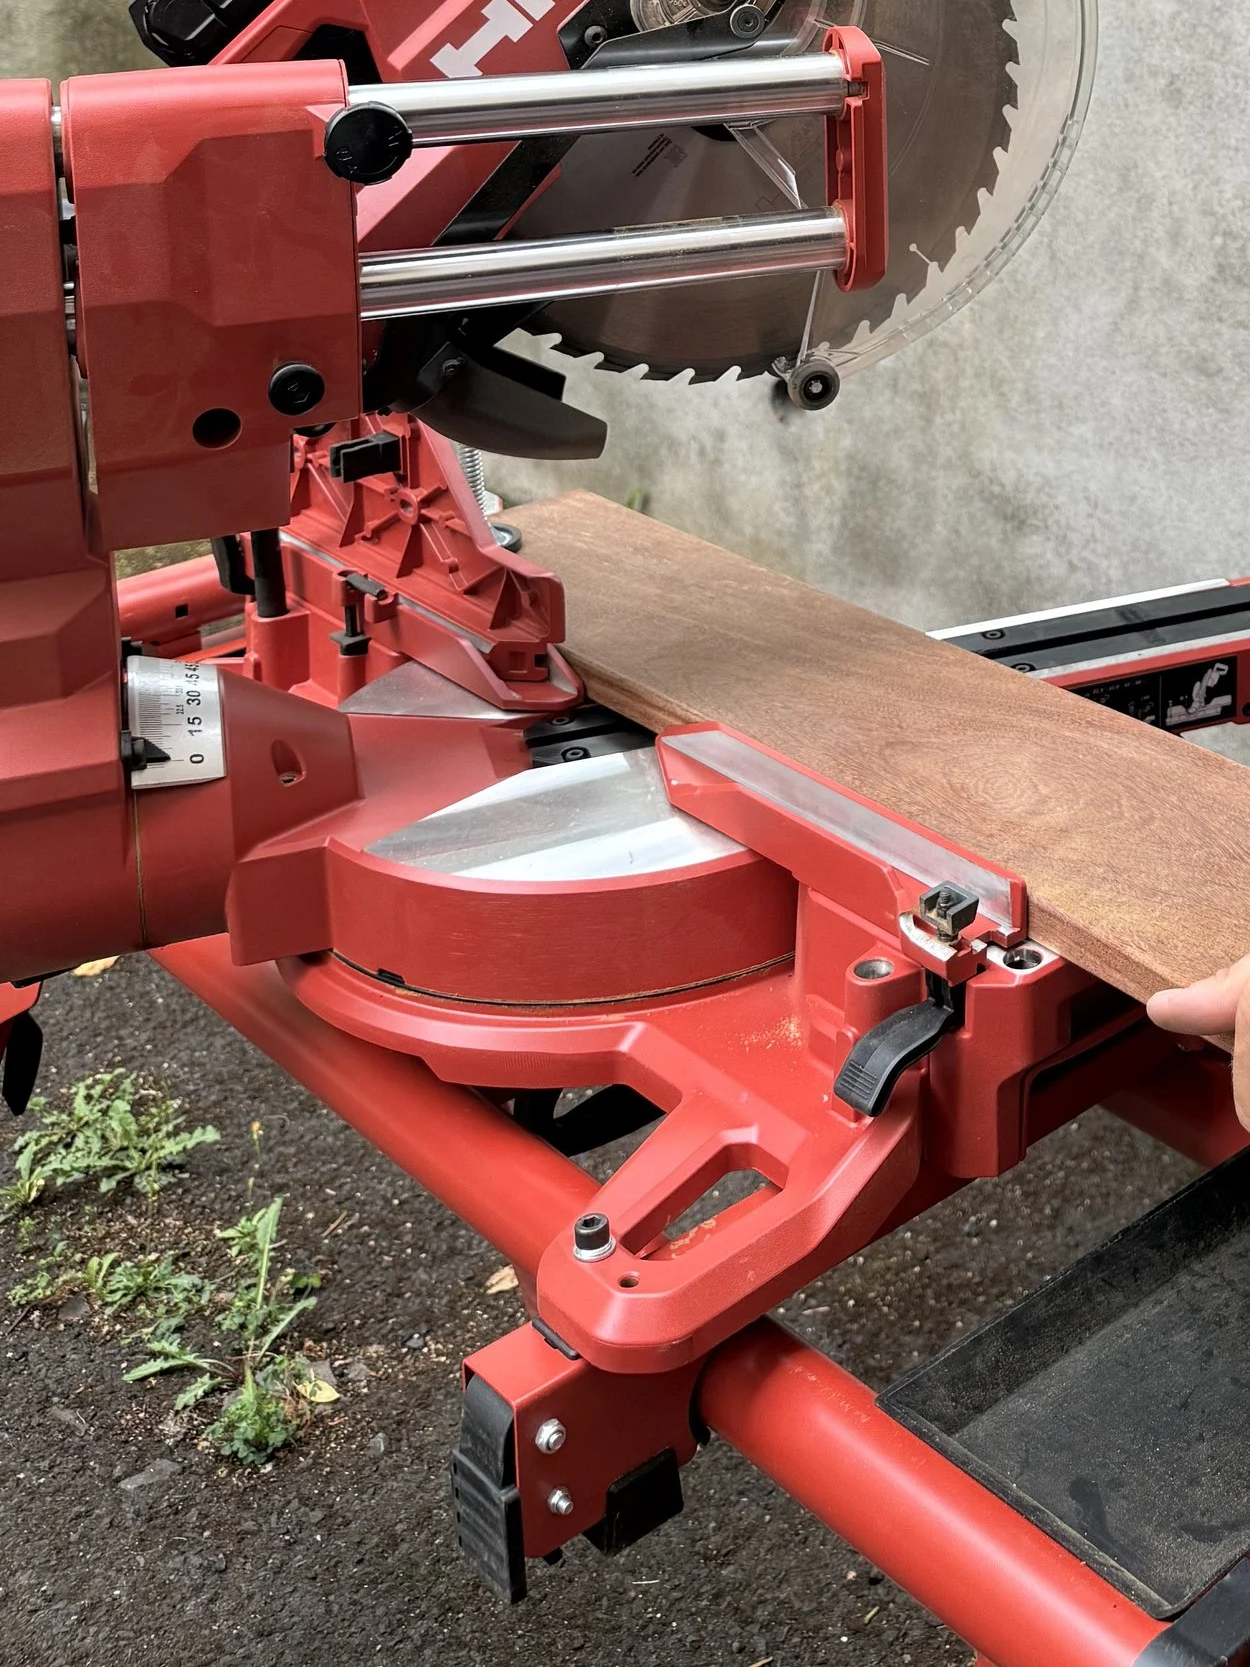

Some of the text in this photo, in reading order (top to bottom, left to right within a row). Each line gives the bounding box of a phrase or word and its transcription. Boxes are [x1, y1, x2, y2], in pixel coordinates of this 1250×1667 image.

[186, 690, 201, 706] 30
[188, 717, 202, 736] 15
[190, 754, 204, 764] 0
